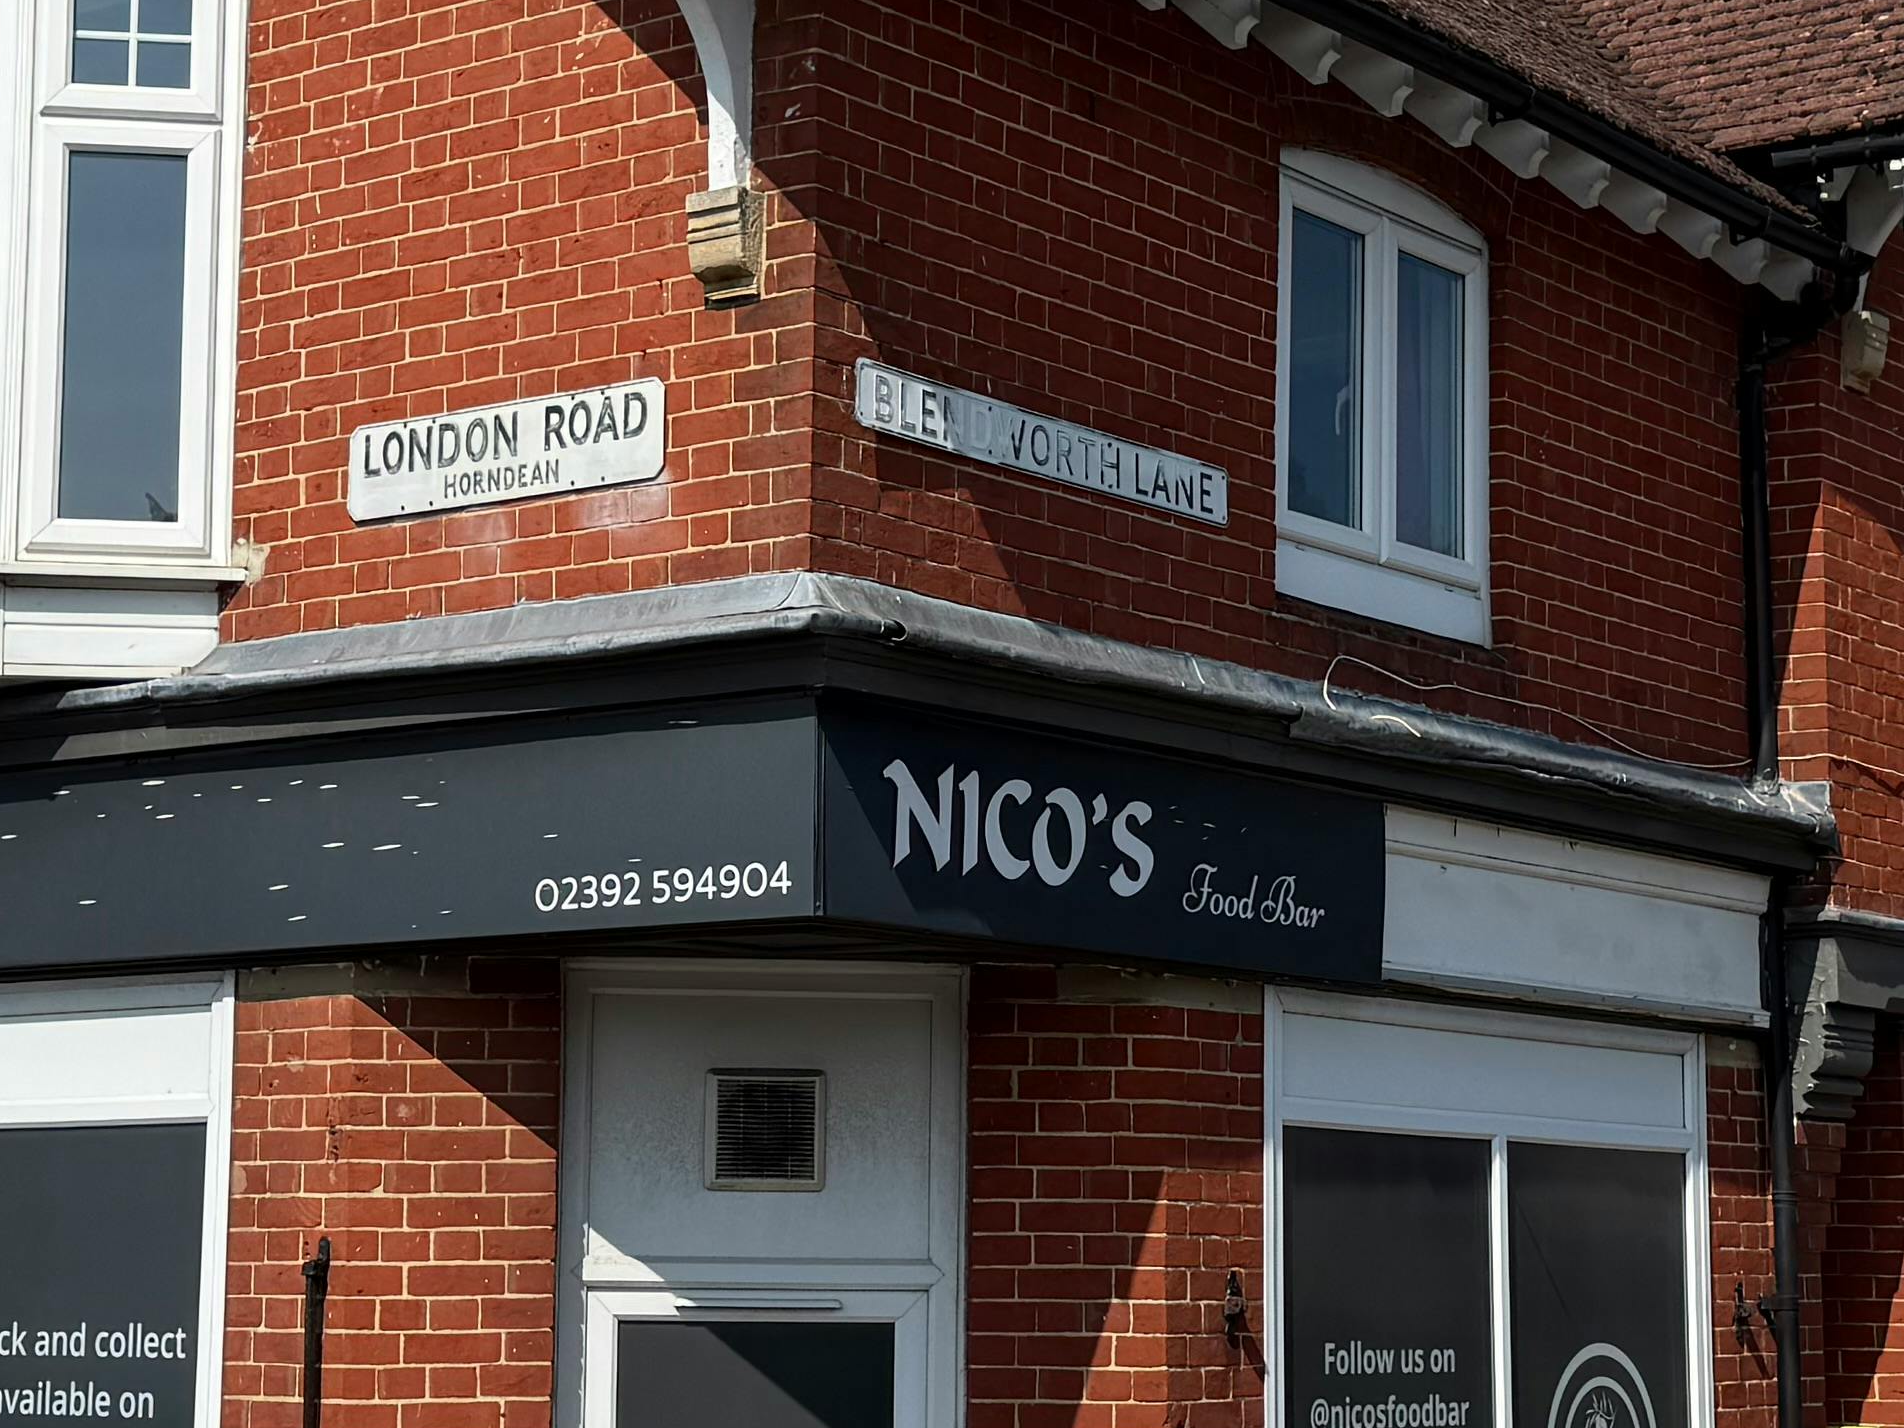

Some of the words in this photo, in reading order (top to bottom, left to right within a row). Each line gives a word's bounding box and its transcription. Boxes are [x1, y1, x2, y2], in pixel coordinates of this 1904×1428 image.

[363, 410, 519, 479] LONDON
[544, 391, 648, 451] ROAD
[873, 373, 1121, 490] BLENDWORTH
[1135, 452, 1214, 514] LANE
[444, 459, 560, 499] HORNDEAN
[882, 759, 1156, 898] NICO'S
[1182, 863, 1259, 920] Food
[1260, 875, 1326, 929] Bar
[535, 872, 641, 912] 02392
[652, 860, 792, 904] 594904
[34, 1322, 86, 1358] and
[95, 1322, 187, 1360] collect
[1324, 1340, 1394, 1375] Follow
[1400, 1346, 1424, 1375] us
[1430, 1345, 1456, 1373] on
[119, 1390, 155, 1419] on
